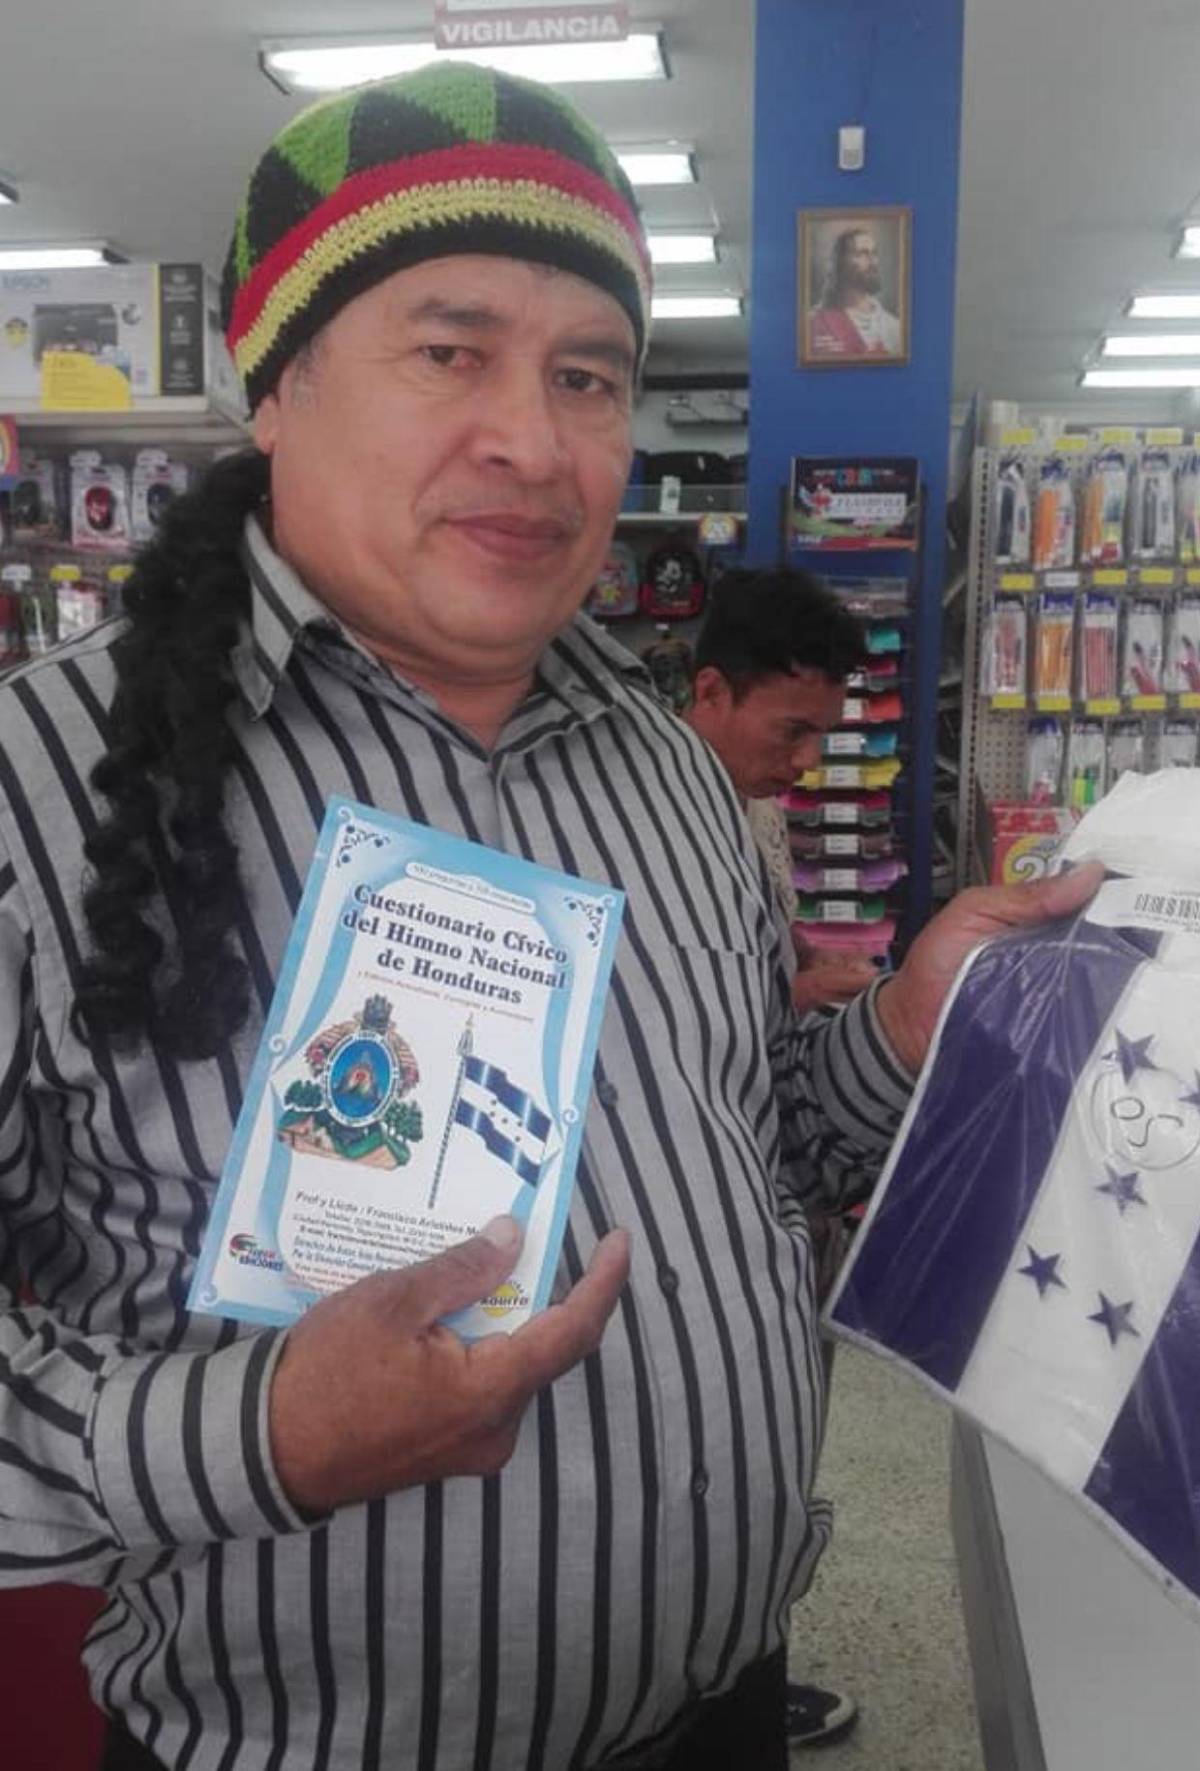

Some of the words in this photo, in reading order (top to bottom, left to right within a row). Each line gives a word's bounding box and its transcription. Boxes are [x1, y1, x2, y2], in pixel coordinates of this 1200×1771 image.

[442, 15, 621, 43] VIGILANCIA
[343, 910, 380, 936] del
[385, 922, 462, 960] Himno
[469, 946, 567, 989] Nacional
[354, 883, 496, 943] Cuestionario
[503, 930, 568, 964] Cívico
[377, 948, 405, 971] de
[411, 956, 523, 1005] Honduras
